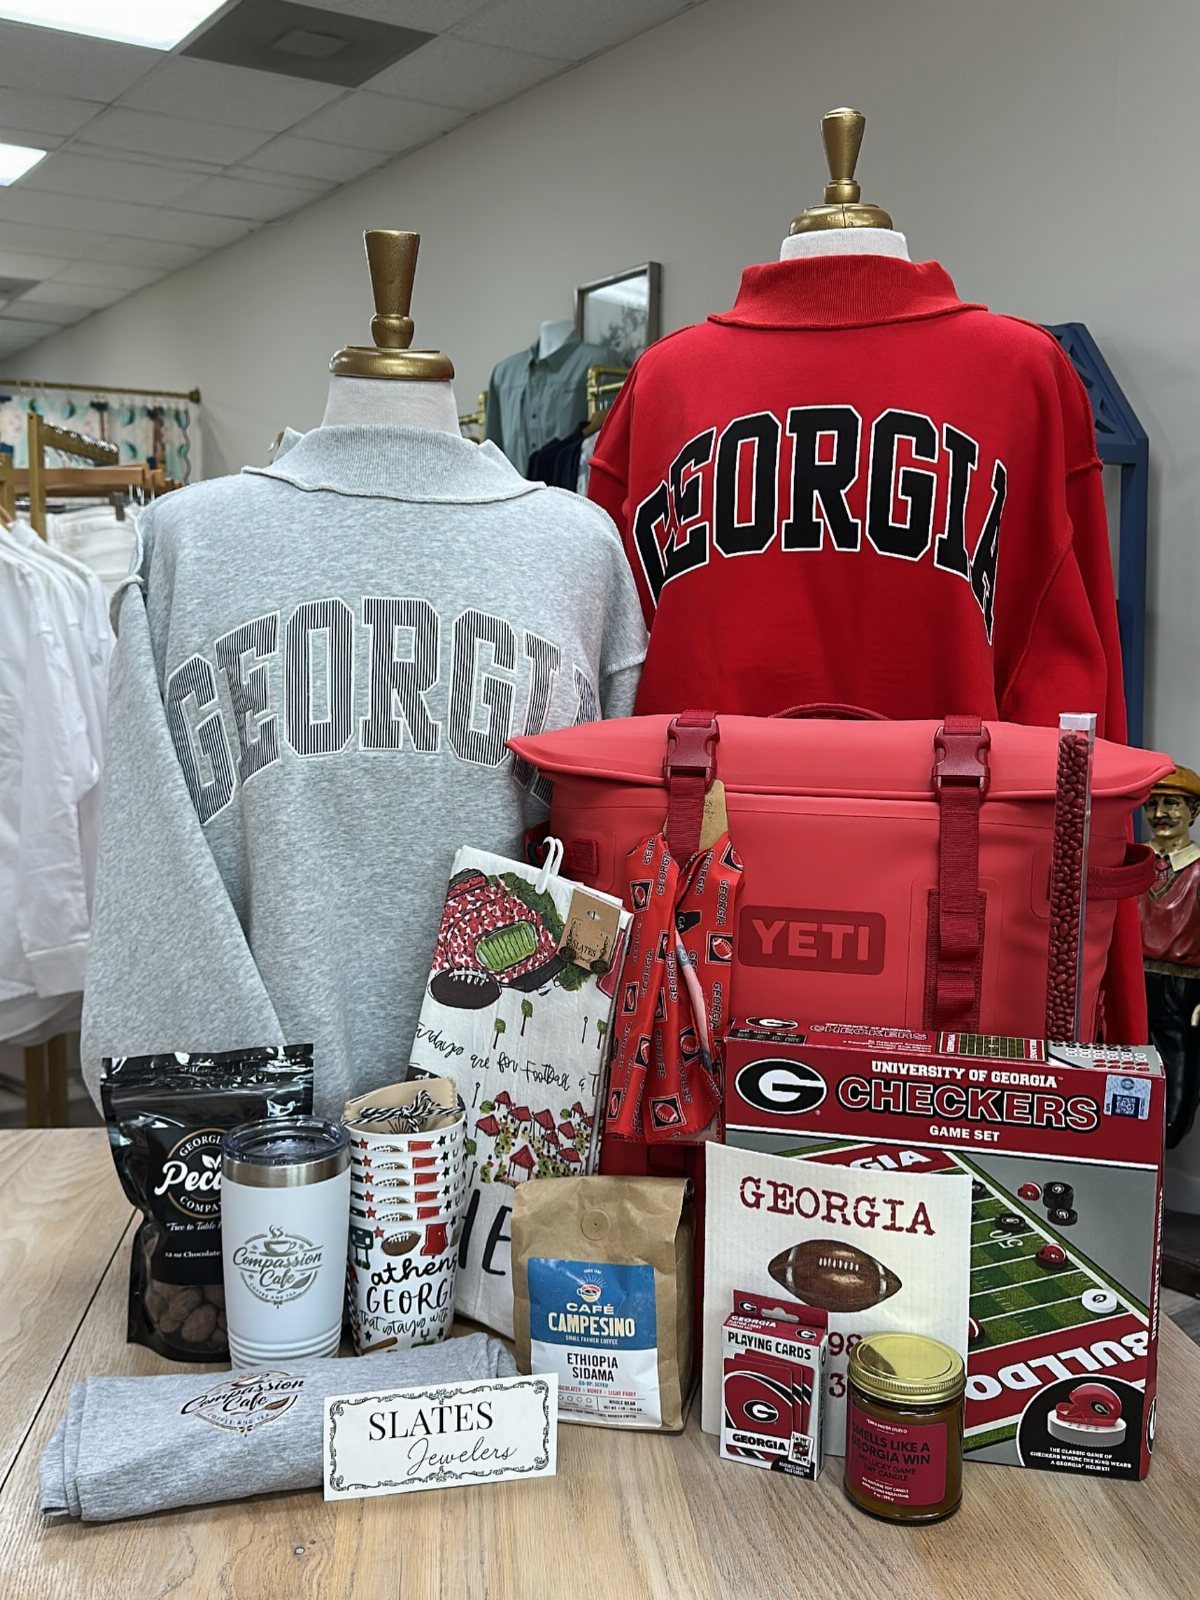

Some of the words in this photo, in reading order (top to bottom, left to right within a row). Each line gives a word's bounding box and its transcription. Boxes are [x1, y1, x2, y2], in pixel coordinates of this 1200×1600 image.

[633, 404, 1007, 646] GEORGIA
[643, 836, 656, 864] GEOR
[695, 849, 715, 896] GEORGIA
[715, 879, 730, 926] GEORGIA
[678, 915, 686, 930] GA
[752, 919, 870, 961] YETI
[666, 949, 679, 1002] GEORGIA
[712, 982, 723, 1031] GEORGIA
[872, 1060, 965, 1080] UNIVERSITY
[969, 1069, 987, 1081] OF
[991, 1072, 1058, 1088] GEORGIA
[838, 1076, 1098, 1130] CHECKERS
[180, 1134, 221, 1157] GEORGI
[930, 1125, 970, 1139] GAME
[974, 1130, 999, 1142] SET
[180, 1195, 221, 1212] COMPA
[740, 1176, 936, 1236] GEORGIA
[233, 1247, 322, 1275] Compassion
[260, 1268, 295, 1289] Cafe
[367, 1278, 453, 1315] GEORGI
[566, 1303, 614, 1315] CAFÉ
[548, 1312, 636, 1337] CAMPESINO
[731, 1315, 776, 1328] GEORGIA
[728, 1331, 772, 1352] PLAYING
[775, 1342, 811, 1360] CARDS
[567, 1353, 619, 1369] ETHIOPIA
[964, 1330, 1149, 1400] BULLDO
[572, 1367, 615, 1382] SIDAMA
[223, 1392, 267, 1412] Cafe
[369, 1401, 493, 1441] SLATES
[732, 1433, 788, 1451] GEORGIA
[890, 1440, 917, 1452] LIKE
[920, 1442, 930, 1452] A
[407, 1436, 517, 1476] Jewelers
[903, 1454, 931, 1465] WIN
[1110, 1461, 1132, 1469] WEARS
[893, 1466, 916, 1475] GAME
